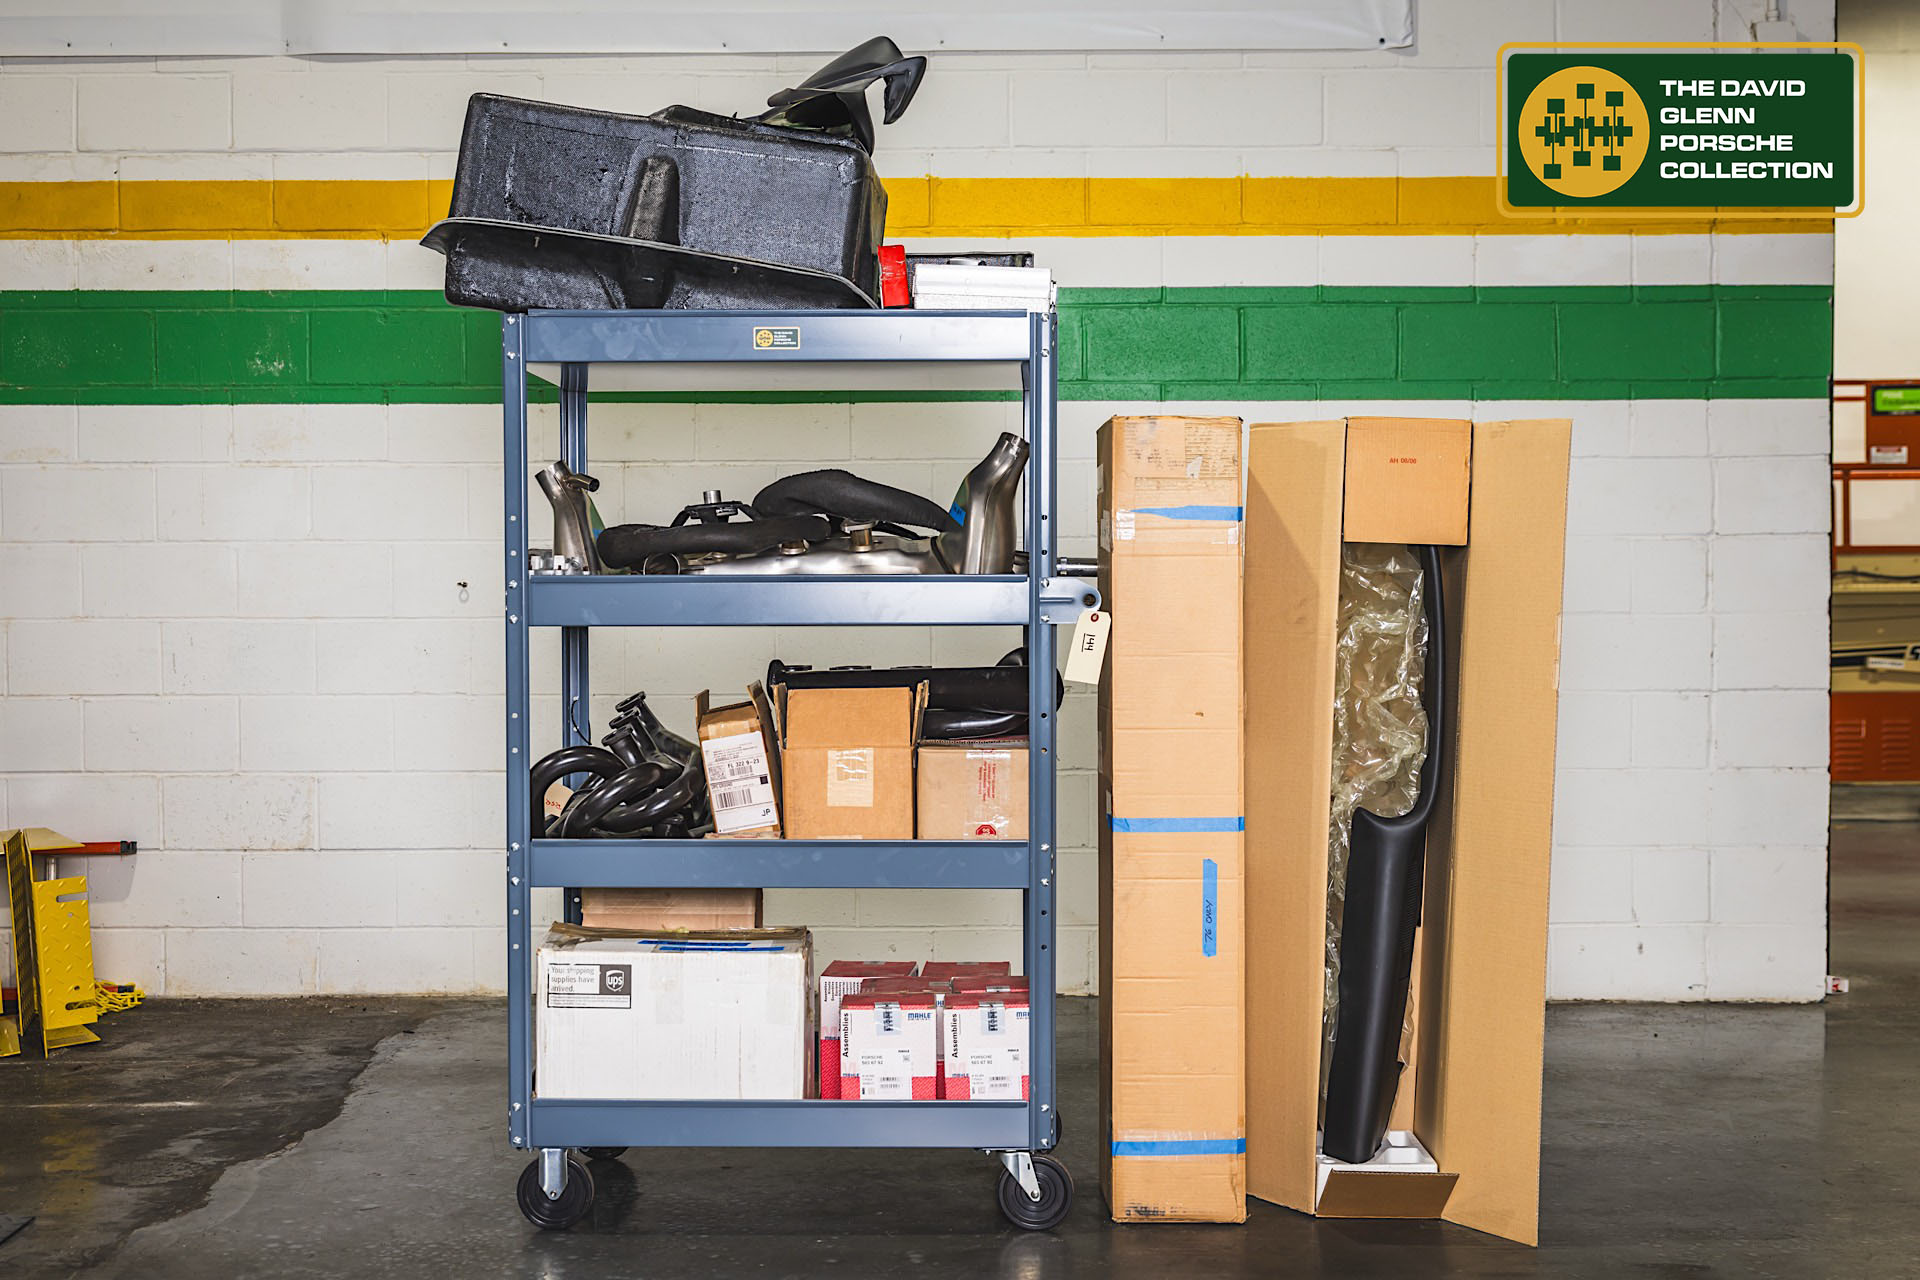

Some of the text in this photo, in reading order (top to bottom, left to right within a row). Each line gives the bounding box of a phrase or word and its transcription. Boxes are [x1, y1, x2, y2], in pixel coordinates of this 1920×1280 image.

[1084, 633, 1096, 651] 144
[761, 808, 771, 817] JP
[551, 976, 577, 984] supplies
[607, 976, 623, 988] ups
